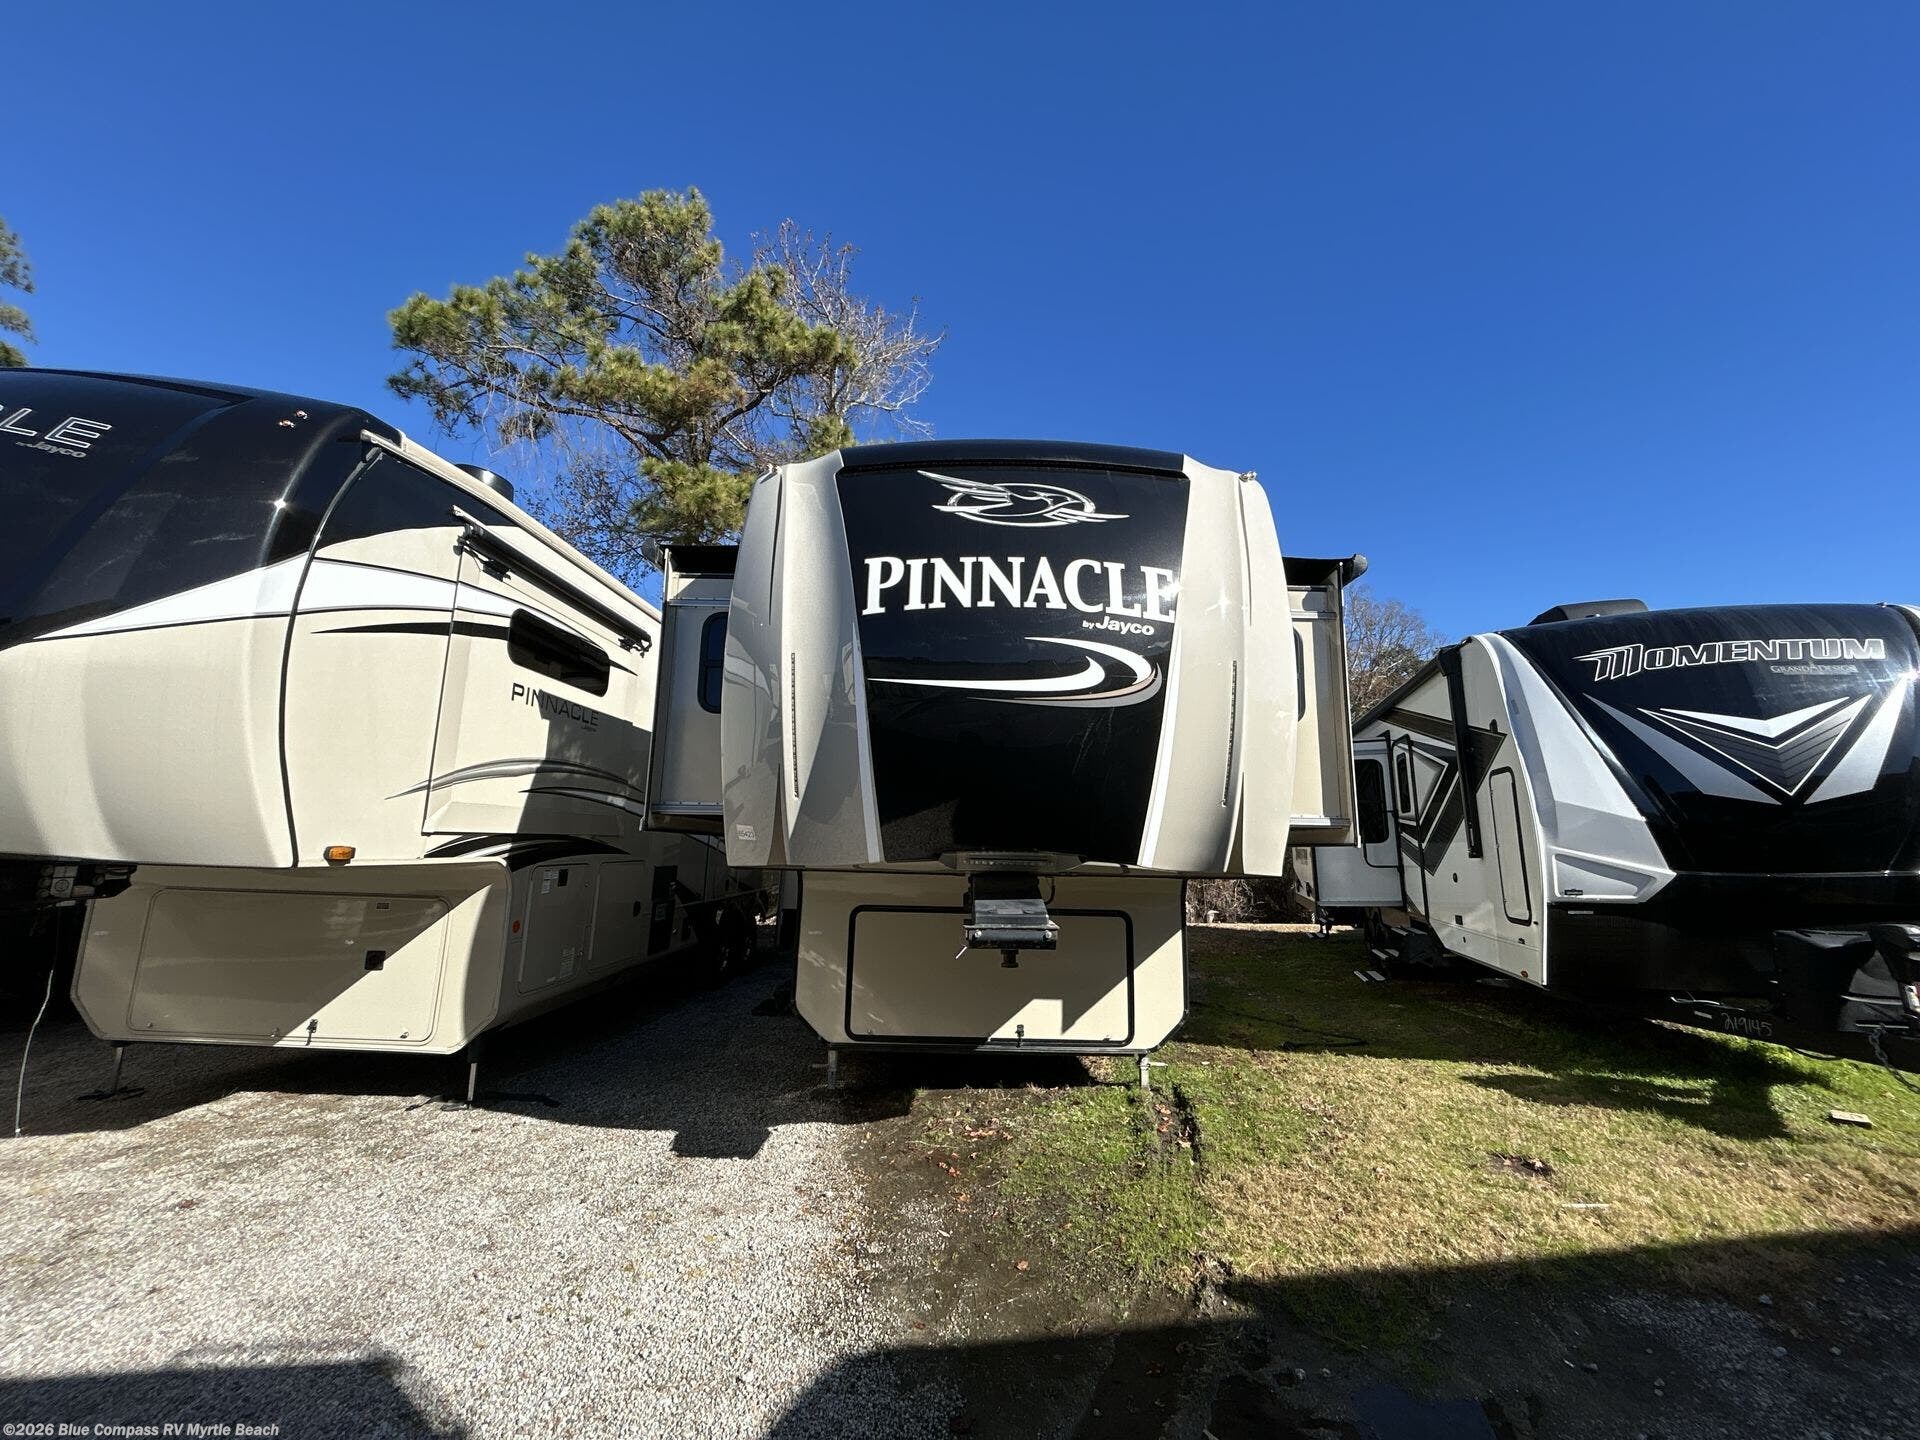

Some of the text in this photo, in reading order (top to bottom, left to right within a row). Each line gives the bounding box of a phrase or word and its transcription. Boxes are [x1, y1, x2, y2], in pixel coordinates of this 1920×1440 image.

[0, 404, 112, 448] LE
[862, 556, 1176, 623] PINNACLE
[1082, 616, 1155, 636] by Jayco
[1571, 638, 1888, 682] MOMENTUM
[511, 682, 600, 726] PINNACLE
